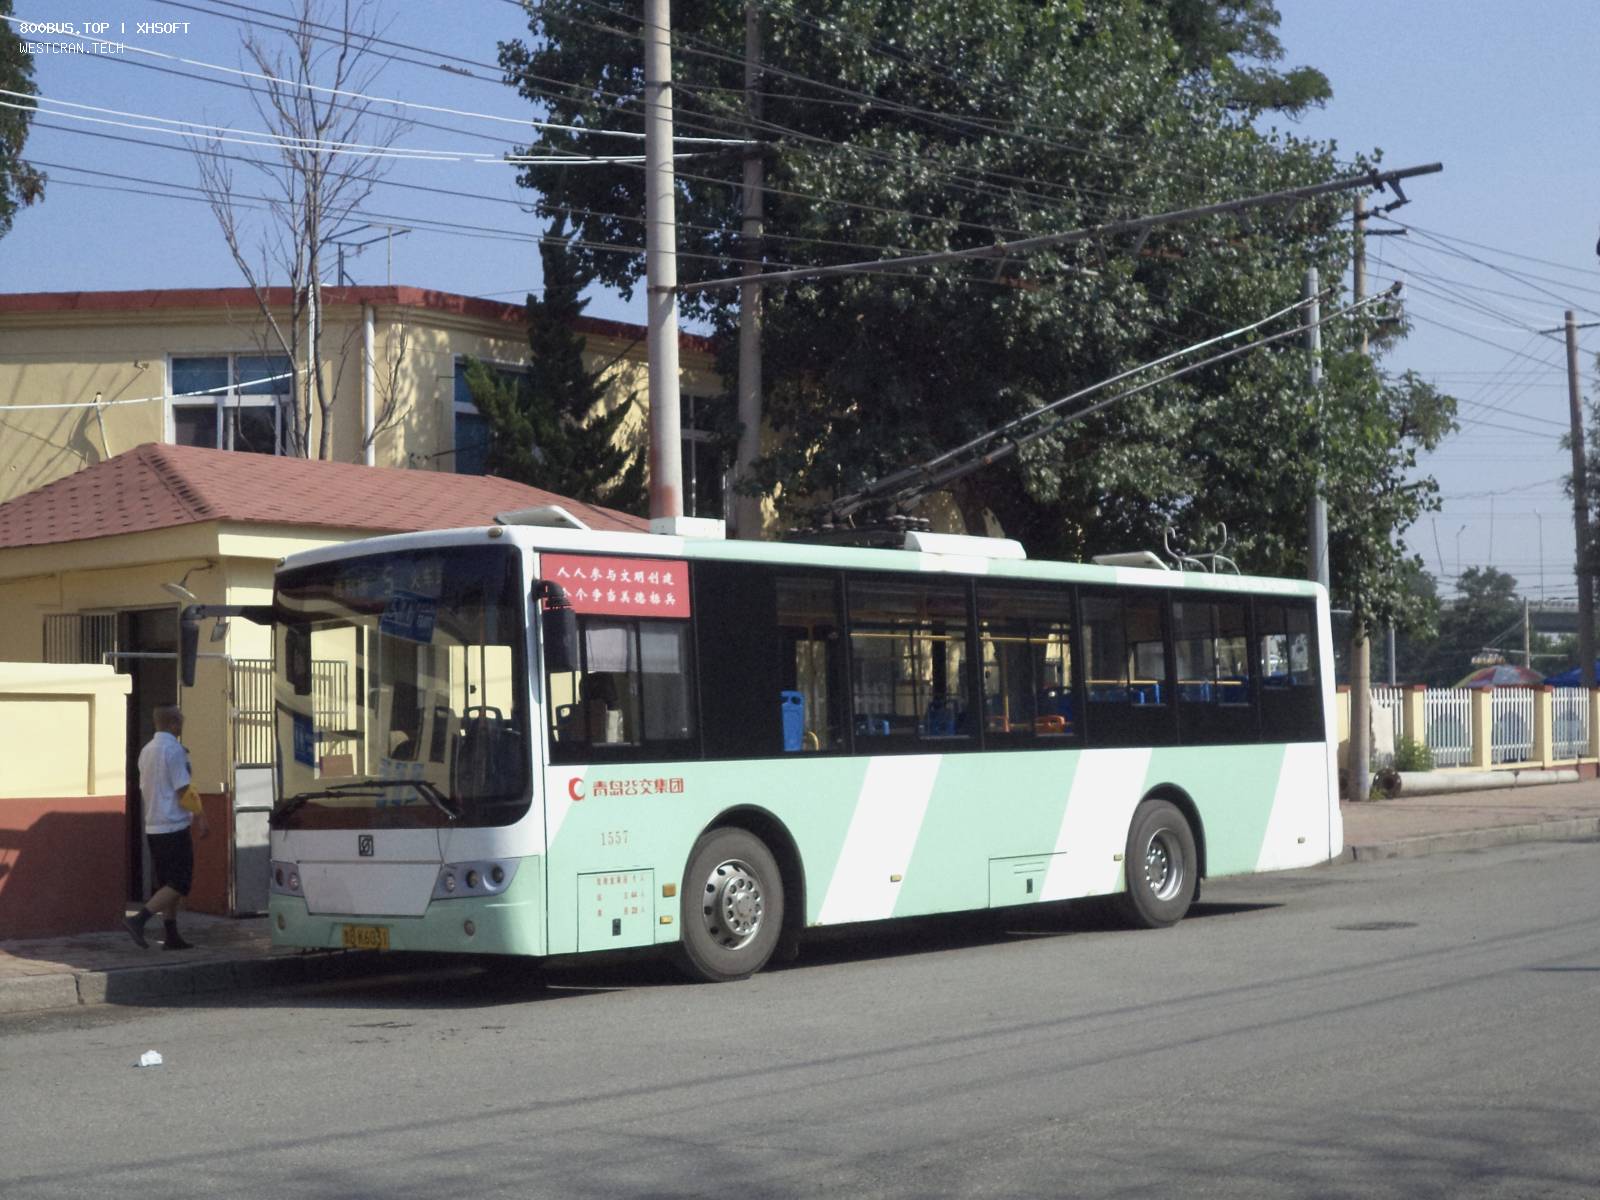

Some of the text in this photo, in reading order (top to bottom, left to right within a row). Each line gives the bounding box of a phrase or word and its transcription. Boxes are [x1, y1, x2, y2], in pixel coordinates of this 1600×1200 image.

[556, 566, 675, 586] 人人参与文明创建
[592, 777, 685, 797] 青岛公交集团
[600, 829, 629, 847] 1557
